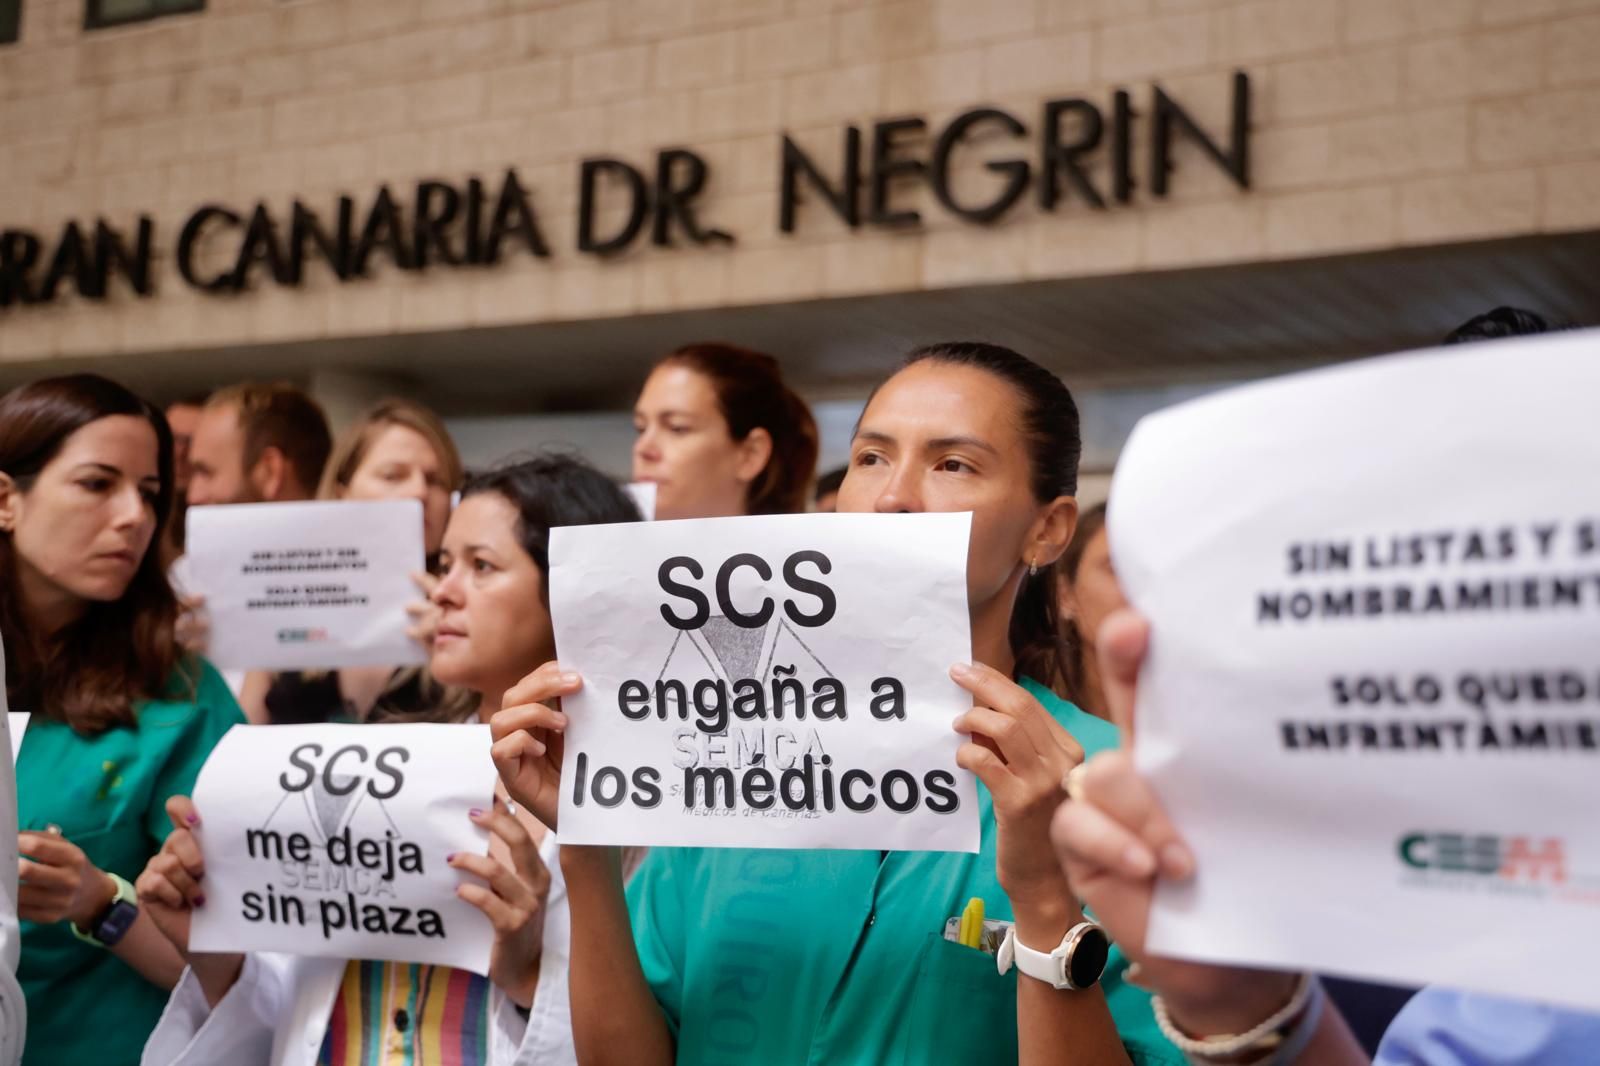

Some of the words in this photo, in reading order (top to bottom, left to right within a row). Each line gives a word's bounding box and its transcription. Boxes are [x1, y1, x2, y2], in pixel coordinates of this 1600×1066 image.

[176, 167, 552, 293] CANARIA
[576, 147, 736, 256] DR.
[778, 71, 1253, 233] NEGRIN
[1287, 542, 1352, 577] SIN
[1366, 525, 1516, 570] LISTAS
[1531, 522, 1559, 558] Y
[657, 549, 837, 631] SCS
[617, 663, 849, 734] engaña
[870, 675, 907, 722] a
[1331, 672, 1443, 708] SOLO
[1458, 669, 1600, 712] QUED
[279, 743, 410, 800] SCS
[671, 726, 825, 771] SEMCA
[572, 751, 663, 810] los
[683, 752, 960, 814] médicos
[246, 828, 312, 863] me
[326, 825, 424, 882] deja
[281, 858, 397, 900] SEMCA
[241, 884, 306, 926] sin
[318, 891, 447, 939] plaza
